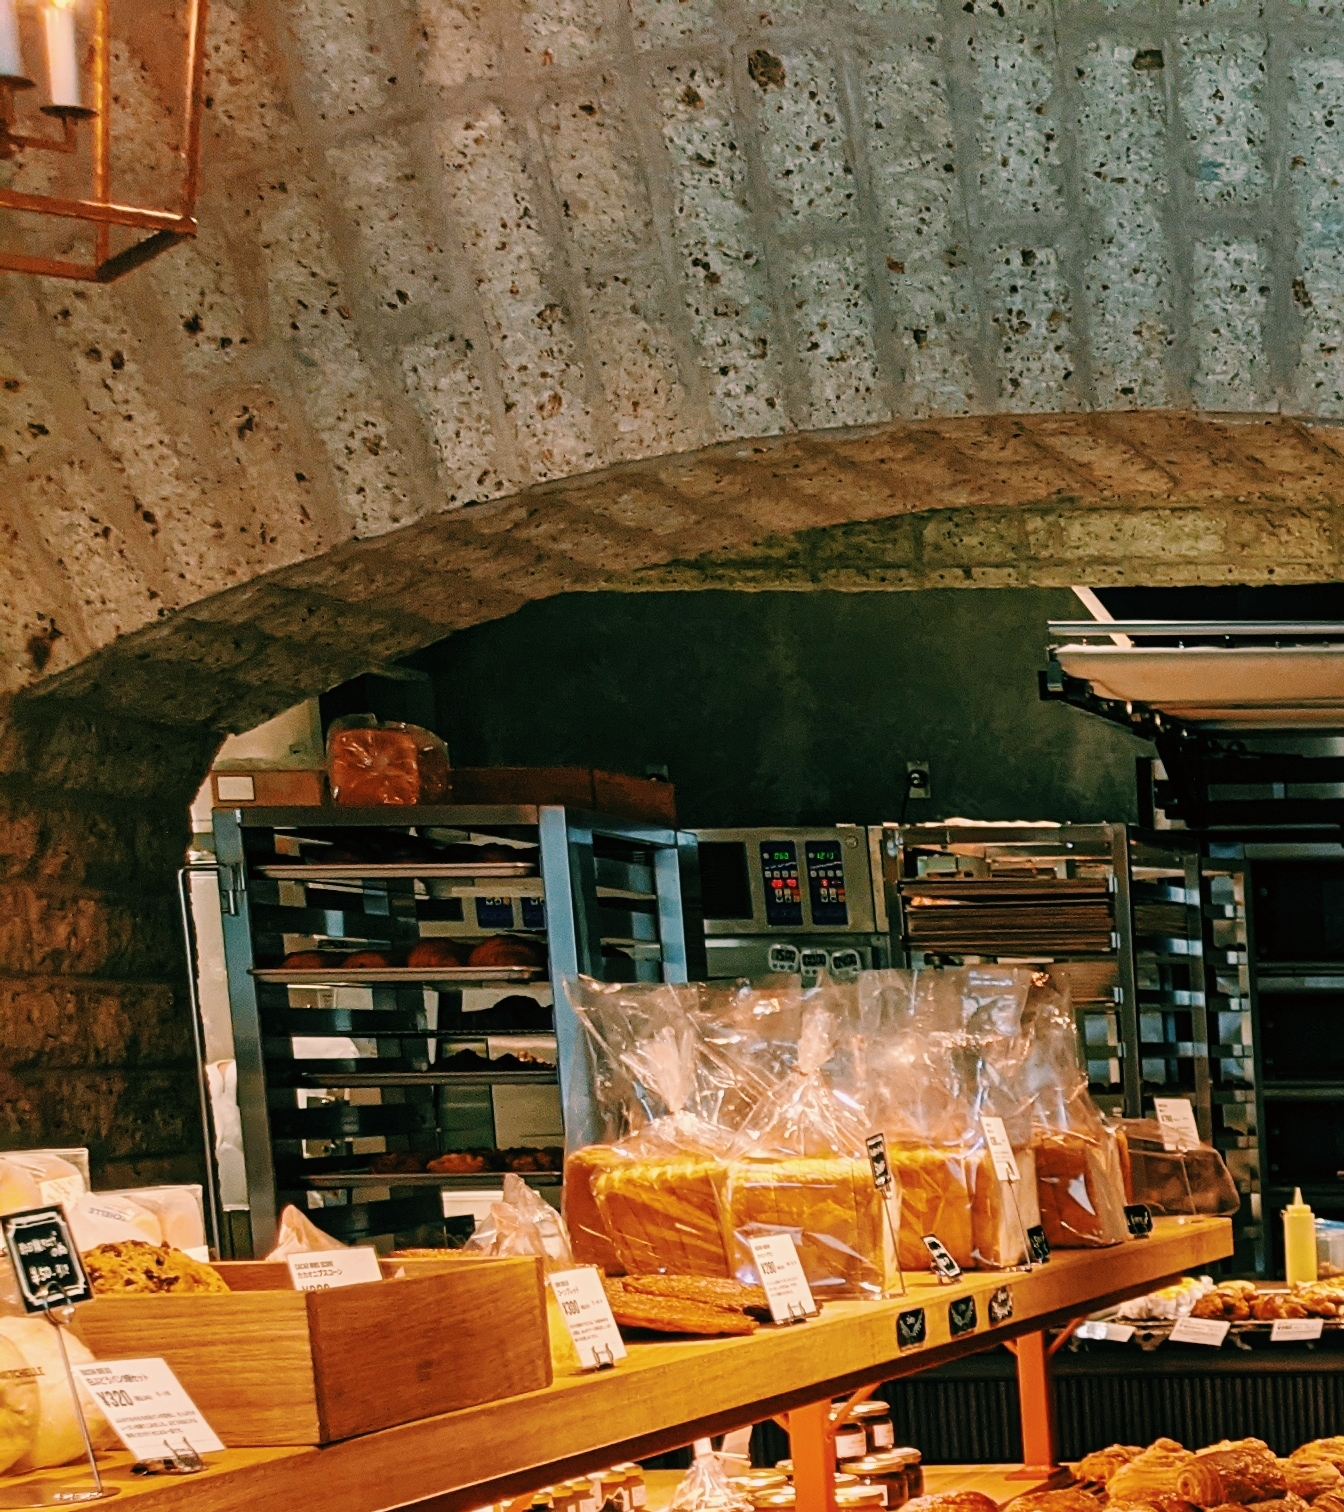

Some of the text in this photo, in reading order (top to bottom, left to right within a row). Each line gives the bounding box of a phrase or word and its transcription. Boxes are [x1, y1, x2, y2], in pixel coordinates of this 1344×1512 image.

[297, 1269, 344, 1280] カカオニブスコーン
[100, 1389, 134, 1408] ¥320
